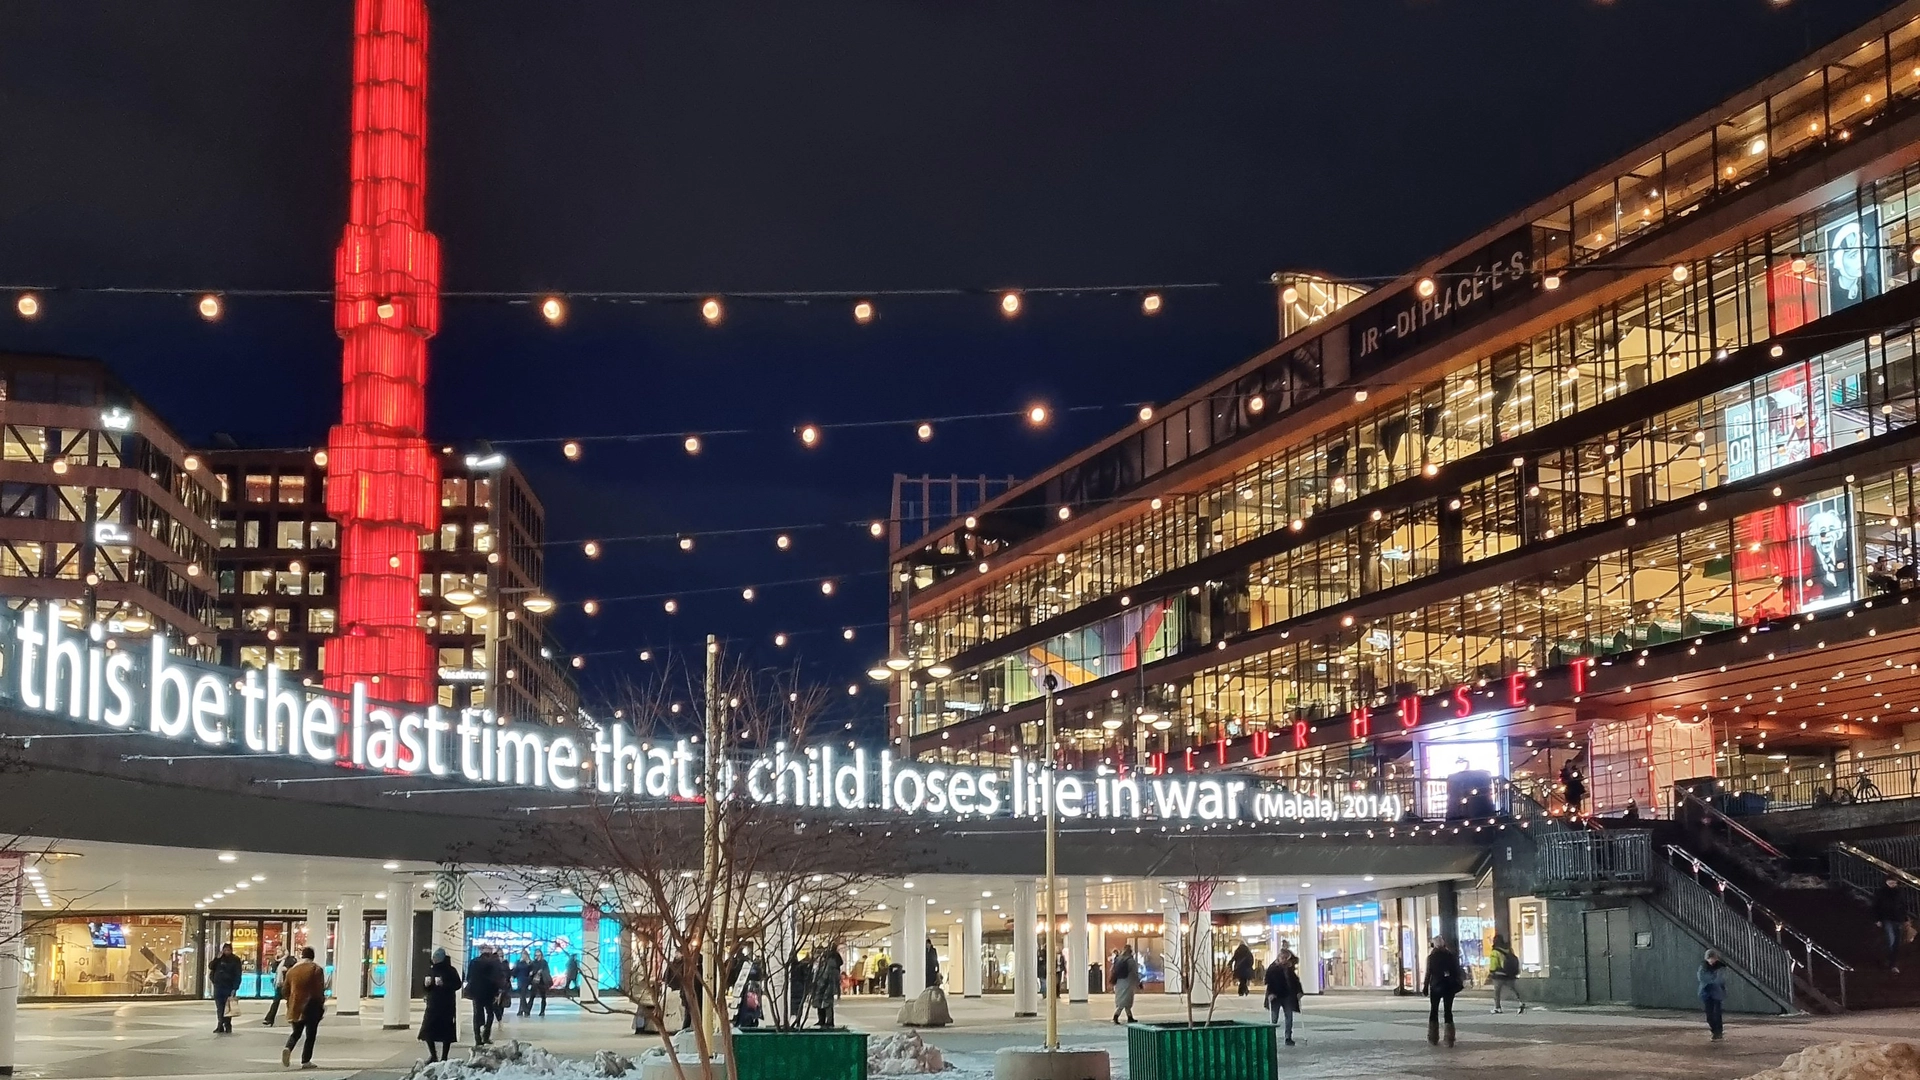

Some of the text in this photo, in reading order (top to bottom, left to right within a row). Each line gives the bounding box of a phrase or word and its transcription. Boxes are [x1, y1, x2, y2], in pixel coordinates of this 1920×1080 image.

[1360, 325, 1379, 357] JR
[17, 602, 134, 728] this
[151, 633, 227, 744] be
[239, 663, 338, 762] the
[352, 682, 448, 776] last
[456, 708, 579, 790] time
[592, 723, 697, 799] that
[747, 741, 866, 809] child
[882, 750, 1000, 816] loses
[1096, 764, 1141, 818] in
[1153, 780, 1245, 820] war
[1255, 793, 1339, 821] (Malala,
[1342, 794, 1401, 822] 2014)
